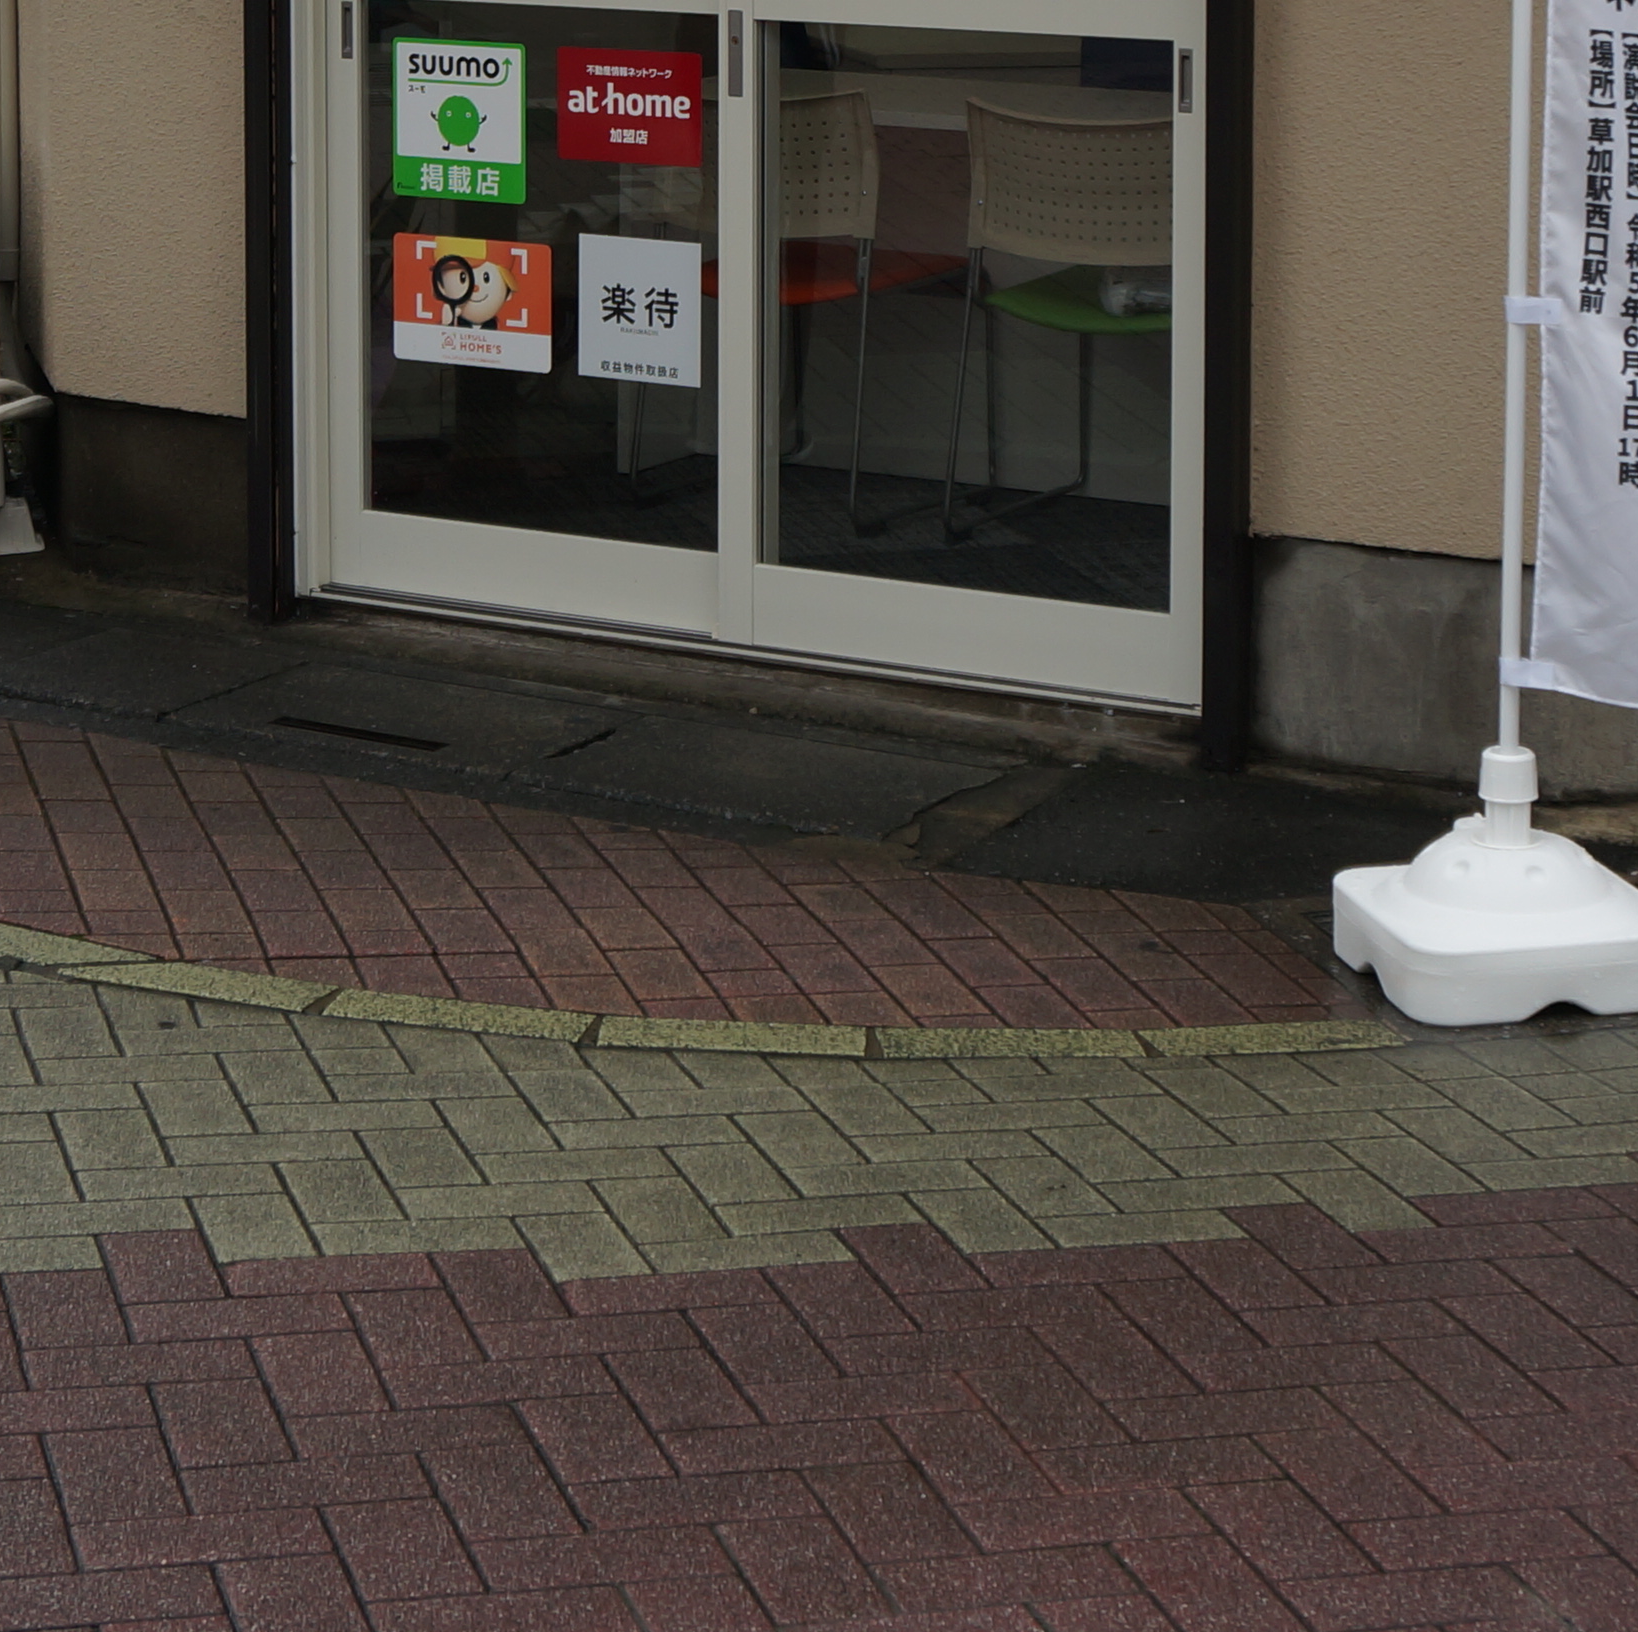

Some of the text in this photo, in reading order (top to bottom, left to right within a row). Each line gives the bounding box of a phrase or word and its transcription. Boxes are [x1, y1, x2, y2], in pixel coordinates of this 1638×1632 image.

[585, 64, 673, 79] 不動産情報ネットワーク
[407, 84, 427, 95] スーモ
[609, 127, 649, 146] 加盟店
[419, 162, 501, 197] 掲載店
[601, 282, 680, 329] 楽待
[459, 342, 502, 355] HOME'S
[600, 360, 680, 380] 収益物件取扱店
